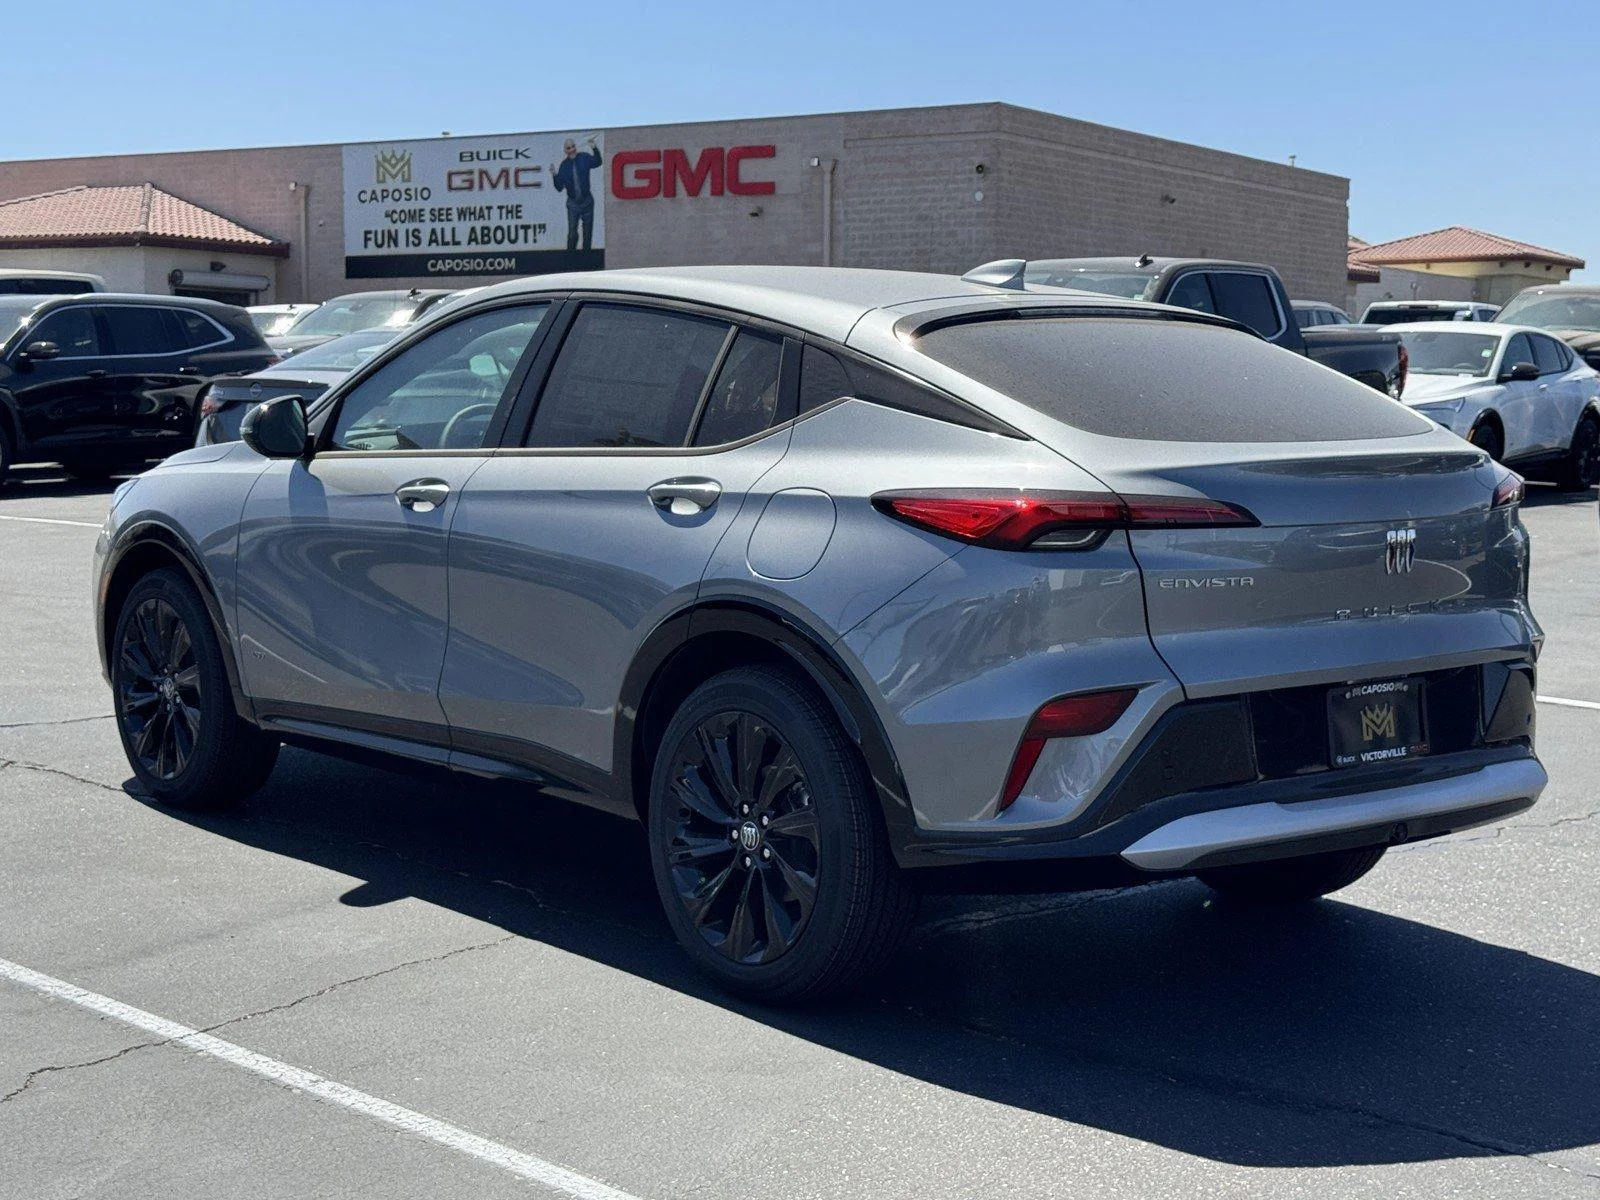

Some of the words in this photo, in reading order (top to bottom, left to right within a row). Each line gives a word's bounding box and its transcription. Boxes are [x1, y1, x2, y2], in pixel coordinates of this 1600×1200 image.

[459, 148, 532, 162] BUICK
[447, 165, 542, 192] GMC
[611, 144, 776, 200] GMC
[358, 187, 431, 204] CAPOSIO
[429, 207, 453, 222] SEE
[456, 205, 493, 221] WHAT
[497, 204, 523, 220] THE
[363, 229, 399, 249] FUN
[405, 228, 422, 247] IS
[428, 226, 461, 246] ALL
[427, 258, 516, 272] CAPOSIO.COM
[1159, 576, 1255, 588] ENVISTA
[1361, 682, 1395, 695] CAPOSIO
[1361, 746, 1408, 762] VICTORVILLE
